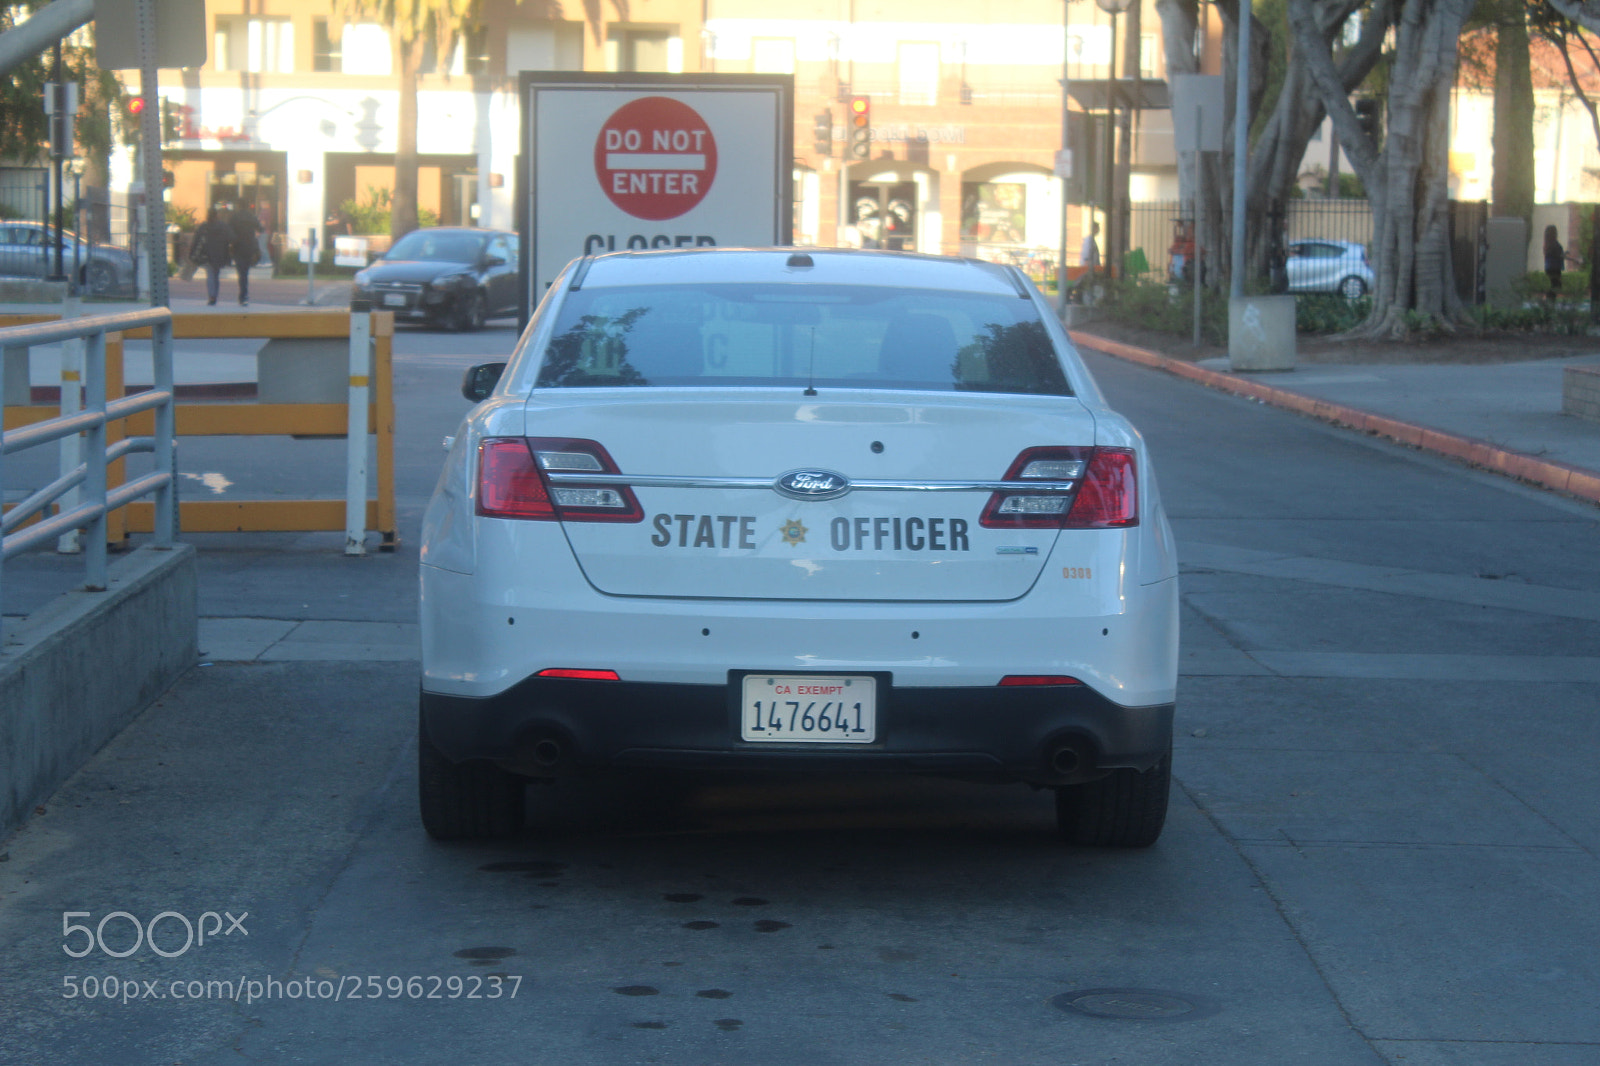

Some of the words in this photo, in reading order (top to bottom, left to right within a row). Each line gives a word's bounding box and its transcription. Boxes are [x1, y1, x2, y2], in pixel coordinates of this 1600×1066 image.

[605, 129, 641, 151] DO
[652, 129, 706, 151] NOT
[612, 172, 699, 195] ENTER
[790, 473, 832, 491] Ford
[651, 512, 757, 550] STATE
[830, 516, 970, 552] OFFICER
[775, 685, 791, 695] CA
[797, 685, 844, 695] EXEMPT
[751, 700, 865, 733] 1476641
